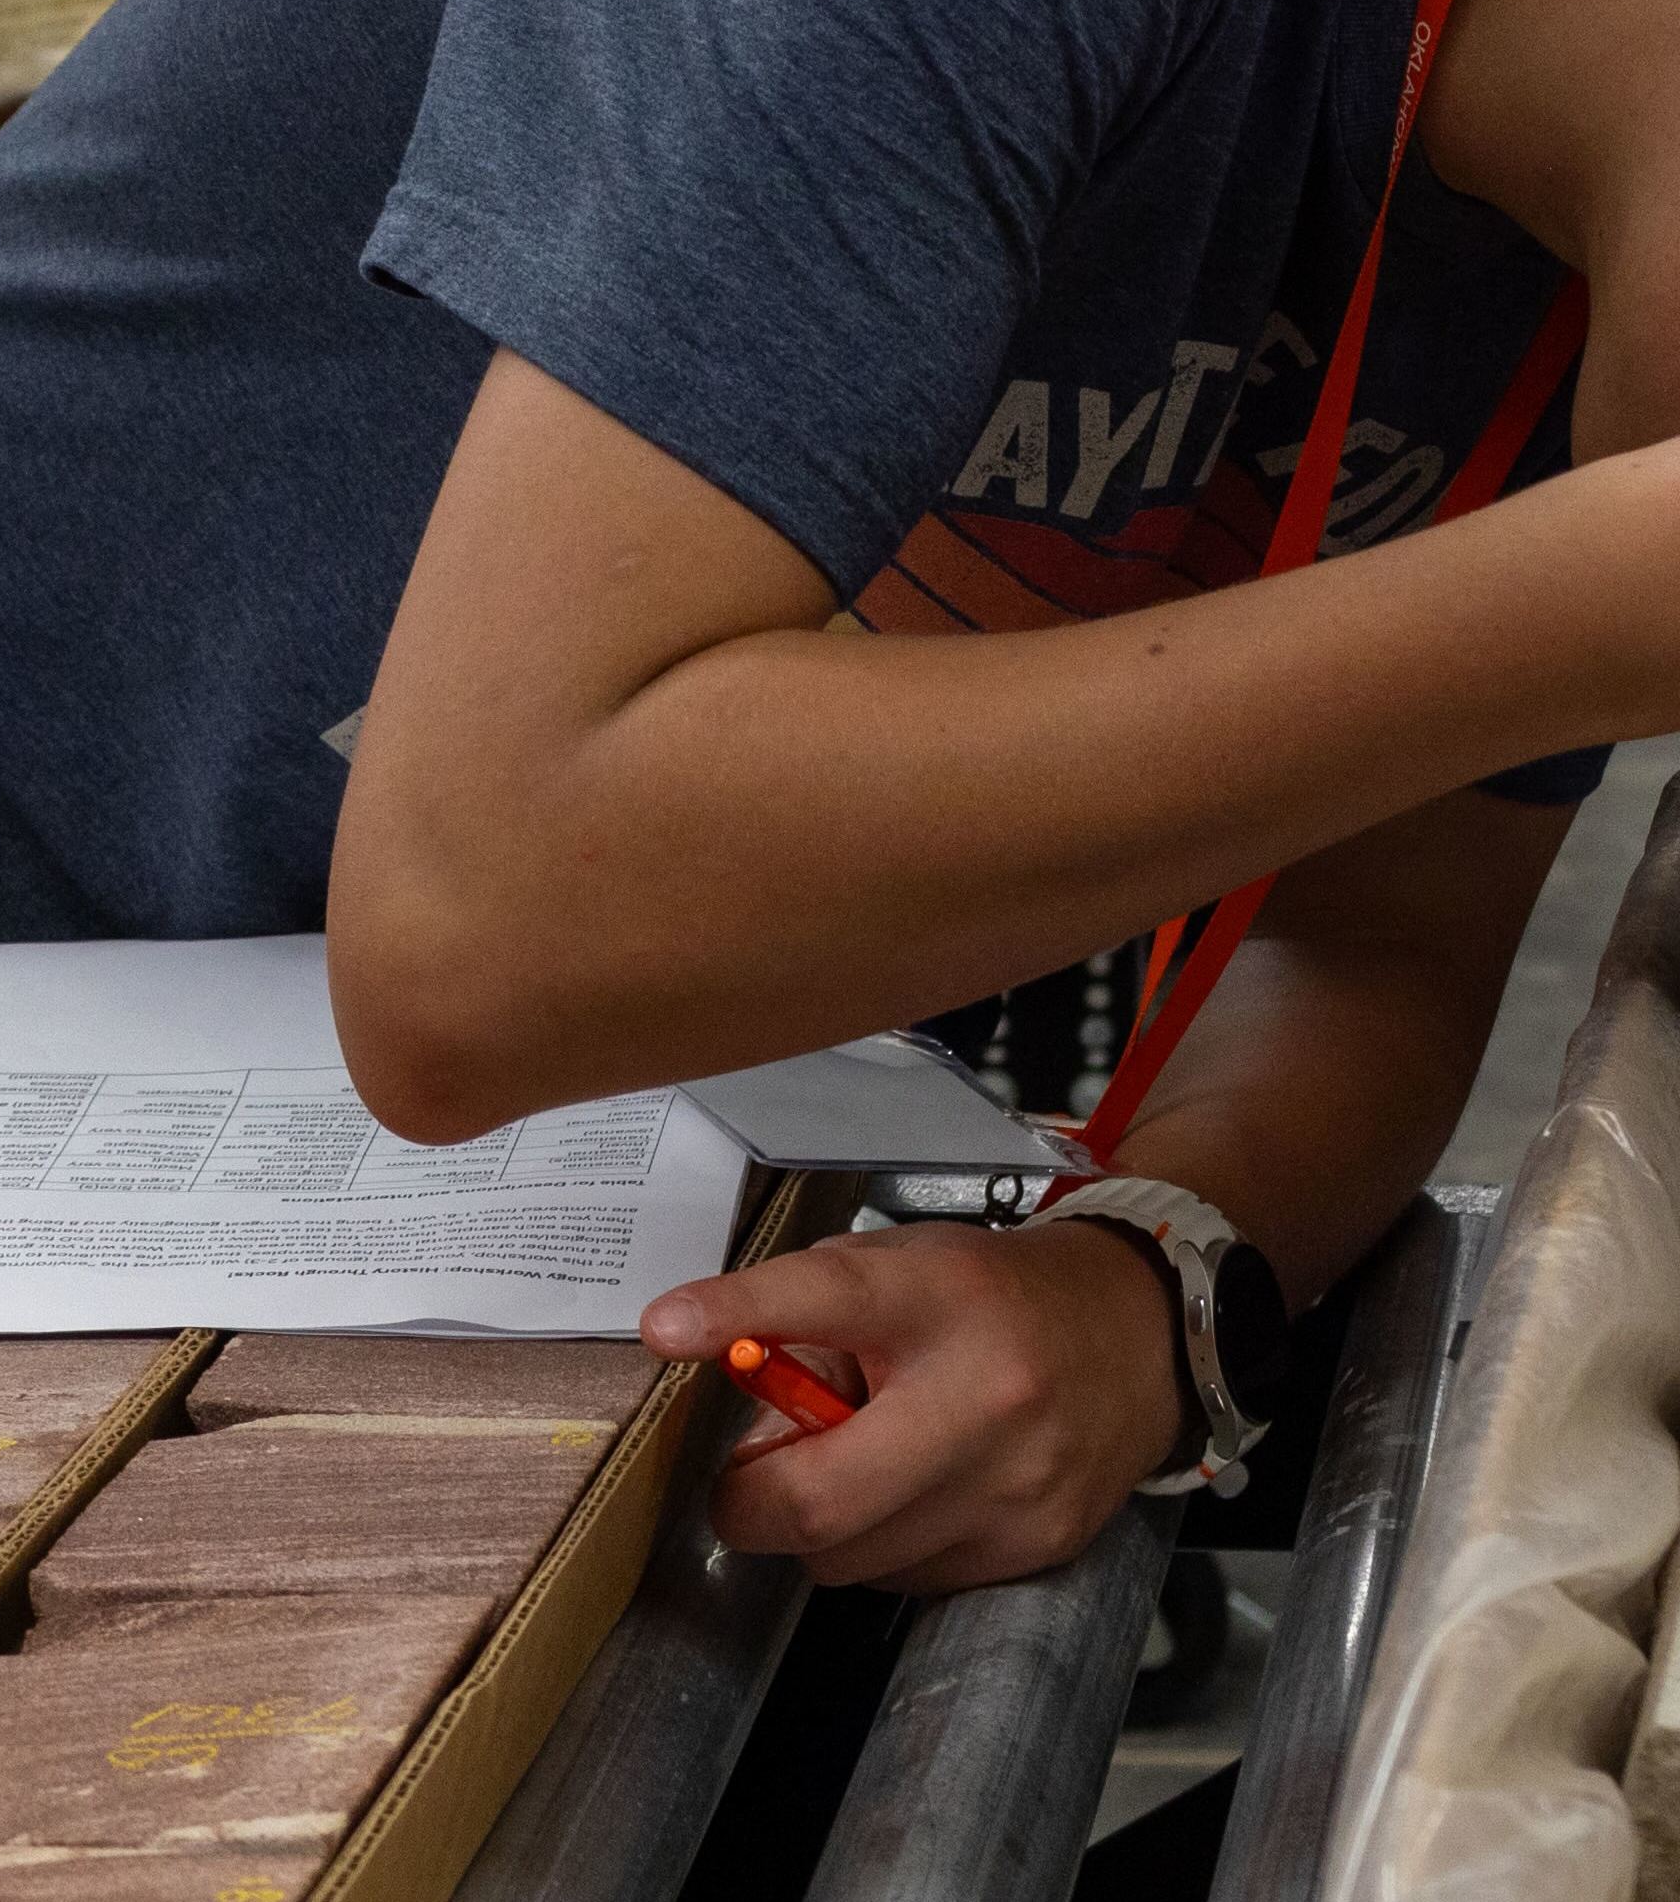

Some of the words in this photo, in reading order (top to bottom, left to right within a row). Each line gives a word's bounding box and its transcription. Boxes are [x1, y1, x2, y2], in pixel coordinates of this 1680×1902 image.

[455, 1182, 566, 1195] Descriptions
[281, 1194, 413, 1202] Interpretations
[421, 1220, 463, 1228] short
[595, 1216, 635, 1225] Then
[561, 1225, 633, 1235] describe
[416, 1234, 631, 1245] geological/environmental
[416, 1245, 452, 1253] core
[457, 1243, 494, 1251] rock
[521, 1244, 585, 1253] number
[563, 1258, 593, 1266] this
[599, 1260, 625, 1269] For
[228, 1270, 289, 1278] Rocks!
[295, 1268, 367, 1276] Through
[445, 1266, 541, 1279] Workshop:
[546, 1272, 620, 1285] Geology
